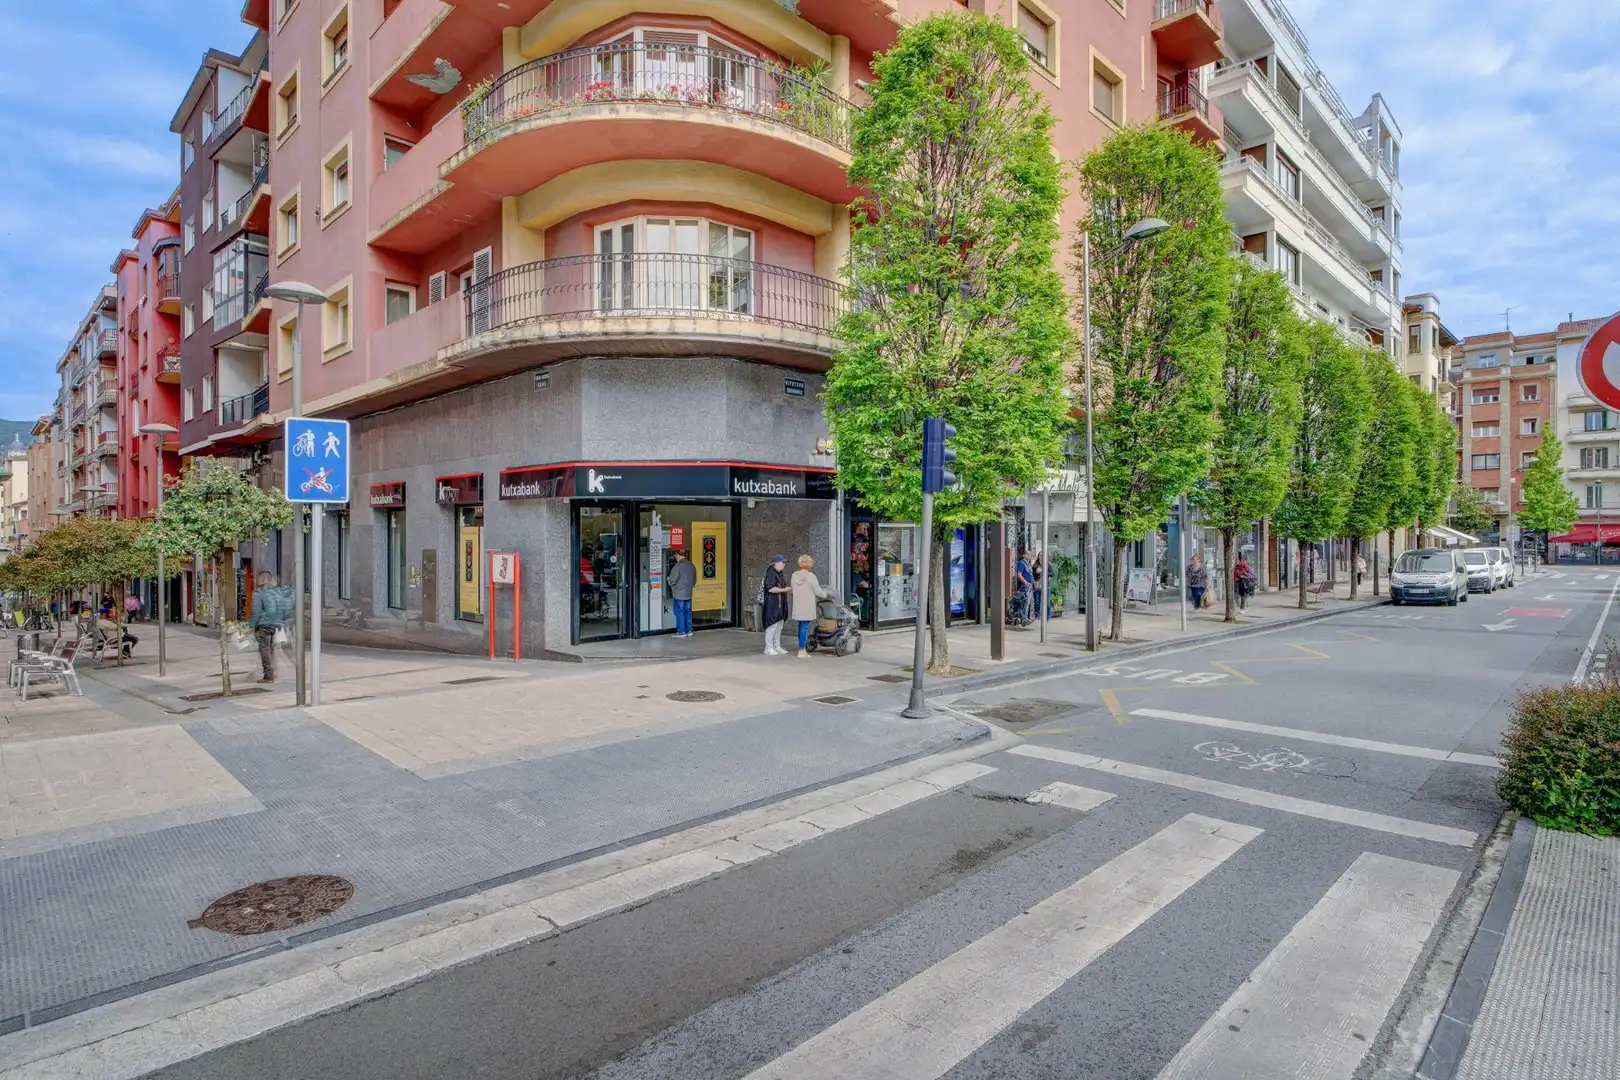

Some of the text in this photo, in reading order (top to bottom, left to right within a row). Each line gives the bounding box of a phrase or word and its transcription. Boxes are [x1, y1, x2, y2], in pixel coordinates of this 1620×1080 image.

[501, 481, 540, 497] kutxabank
[734, 478, 797, 495] kutxabank
[1083, 666, 1230, 684] BUS
